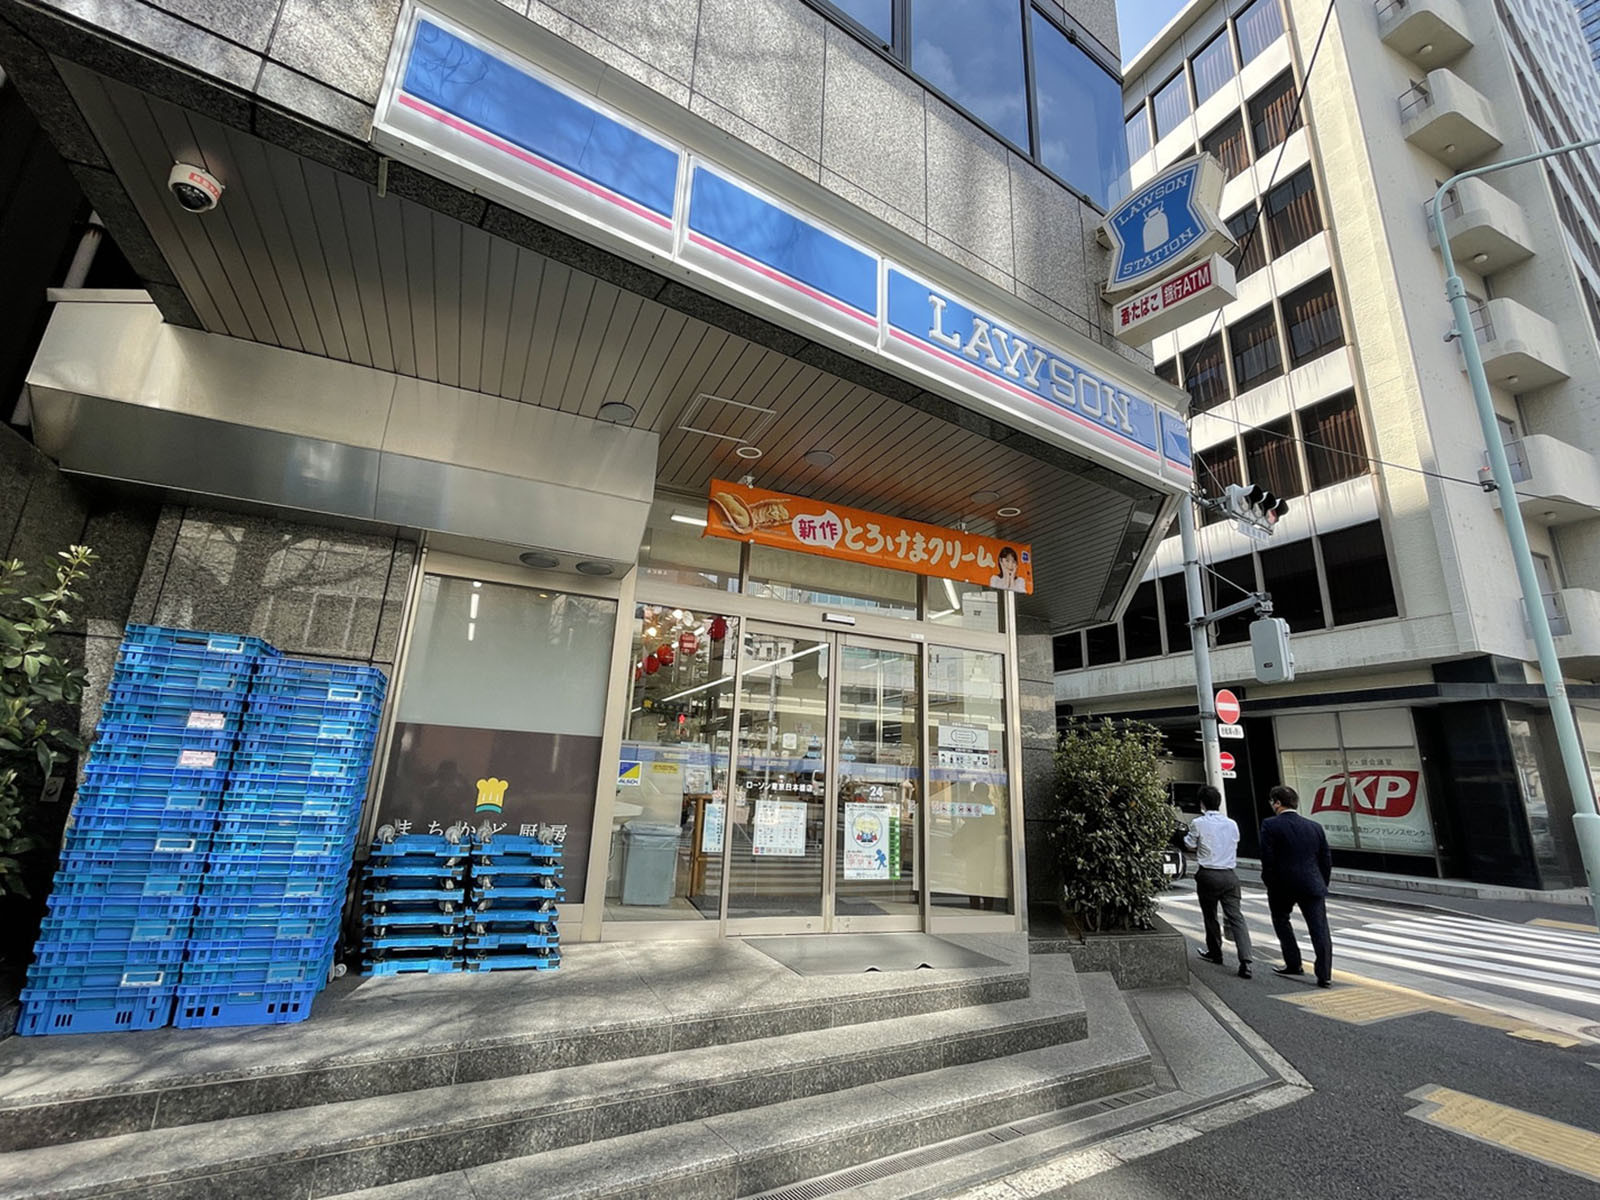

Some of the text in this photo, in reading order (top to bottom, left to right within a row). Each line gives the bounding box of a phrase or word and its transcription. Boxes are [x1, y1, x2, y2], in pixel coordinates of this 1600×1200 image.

[1117, 174, 1190, 226] LAWSON
[1122, 227, 1195, 276] STATION
[1163, 265, 1211, 304] 銀行ATM
[928, 294, 1133, 434] LAWSON
[798, 517, 839, 542] 新作
[869, 785, 883, 797] 24
[1317, 775, 1411, 810] TKP
